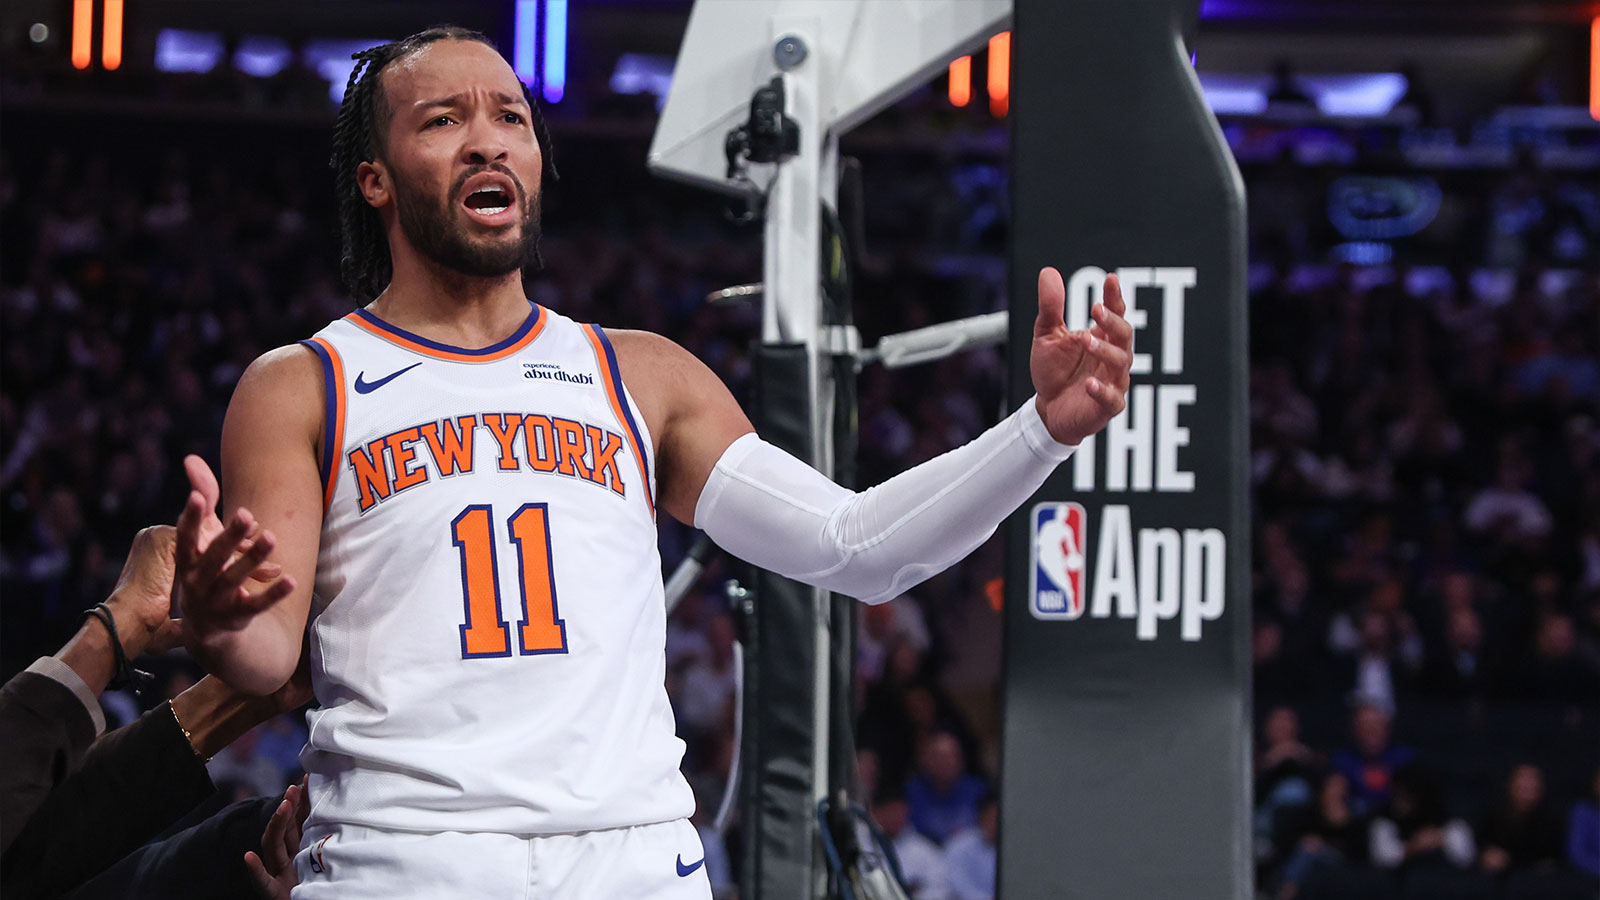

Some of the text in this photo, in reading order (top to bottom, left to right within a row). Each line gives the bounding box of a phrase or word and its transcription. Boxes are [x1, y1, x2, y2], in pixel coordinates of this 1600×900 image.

[524, 369, 593, 385] abu dhabi
[347, 412, 627, 517] NEW YORK
[450, 502, 569, 660] 11
[1038, 590, 1066, 610] NBA
[1090, 504, 1226, 641] App
